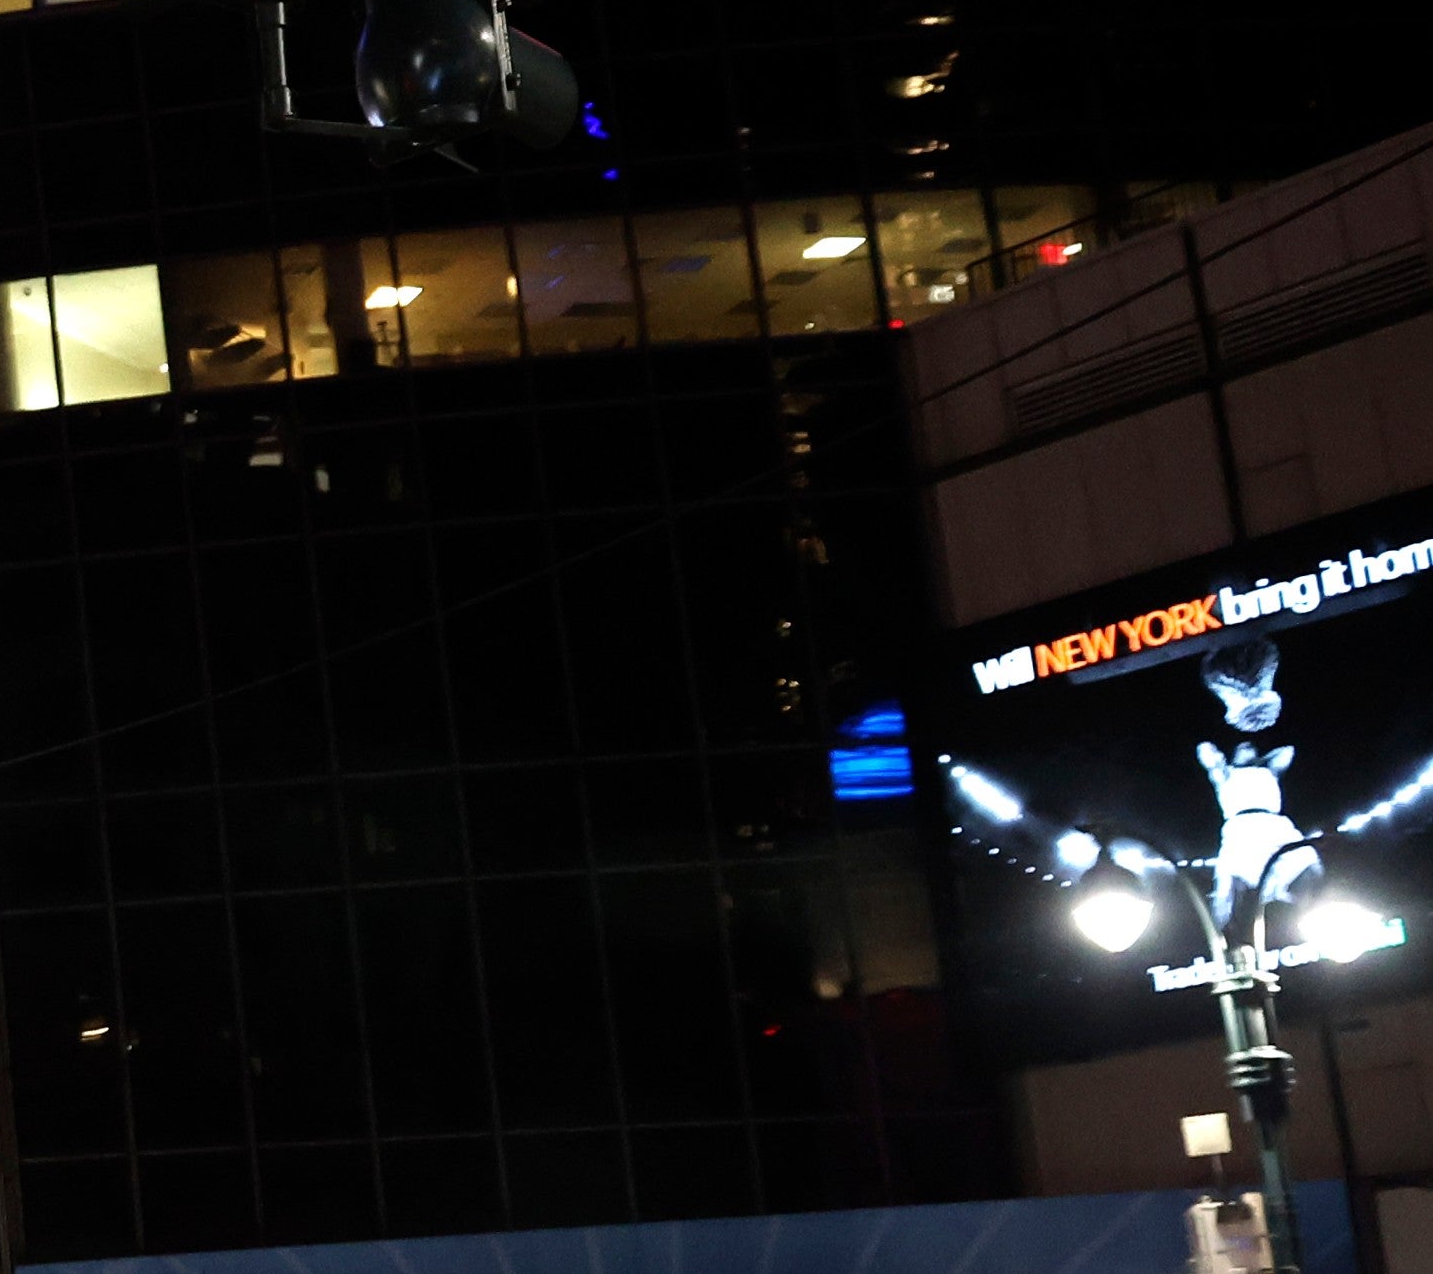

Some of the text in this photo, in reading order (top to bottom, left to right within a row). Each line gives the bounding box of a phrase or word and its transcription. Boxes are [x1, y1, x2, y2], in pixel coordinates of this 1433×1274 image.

[972, 645, 1035, 695] Will
[1034, 623, 1117, 677] NEW
[1118, 594, 1223, 652] YORK
[1219, 578, 1321, 625] bring
[1319, 559, 1352, 597] it
